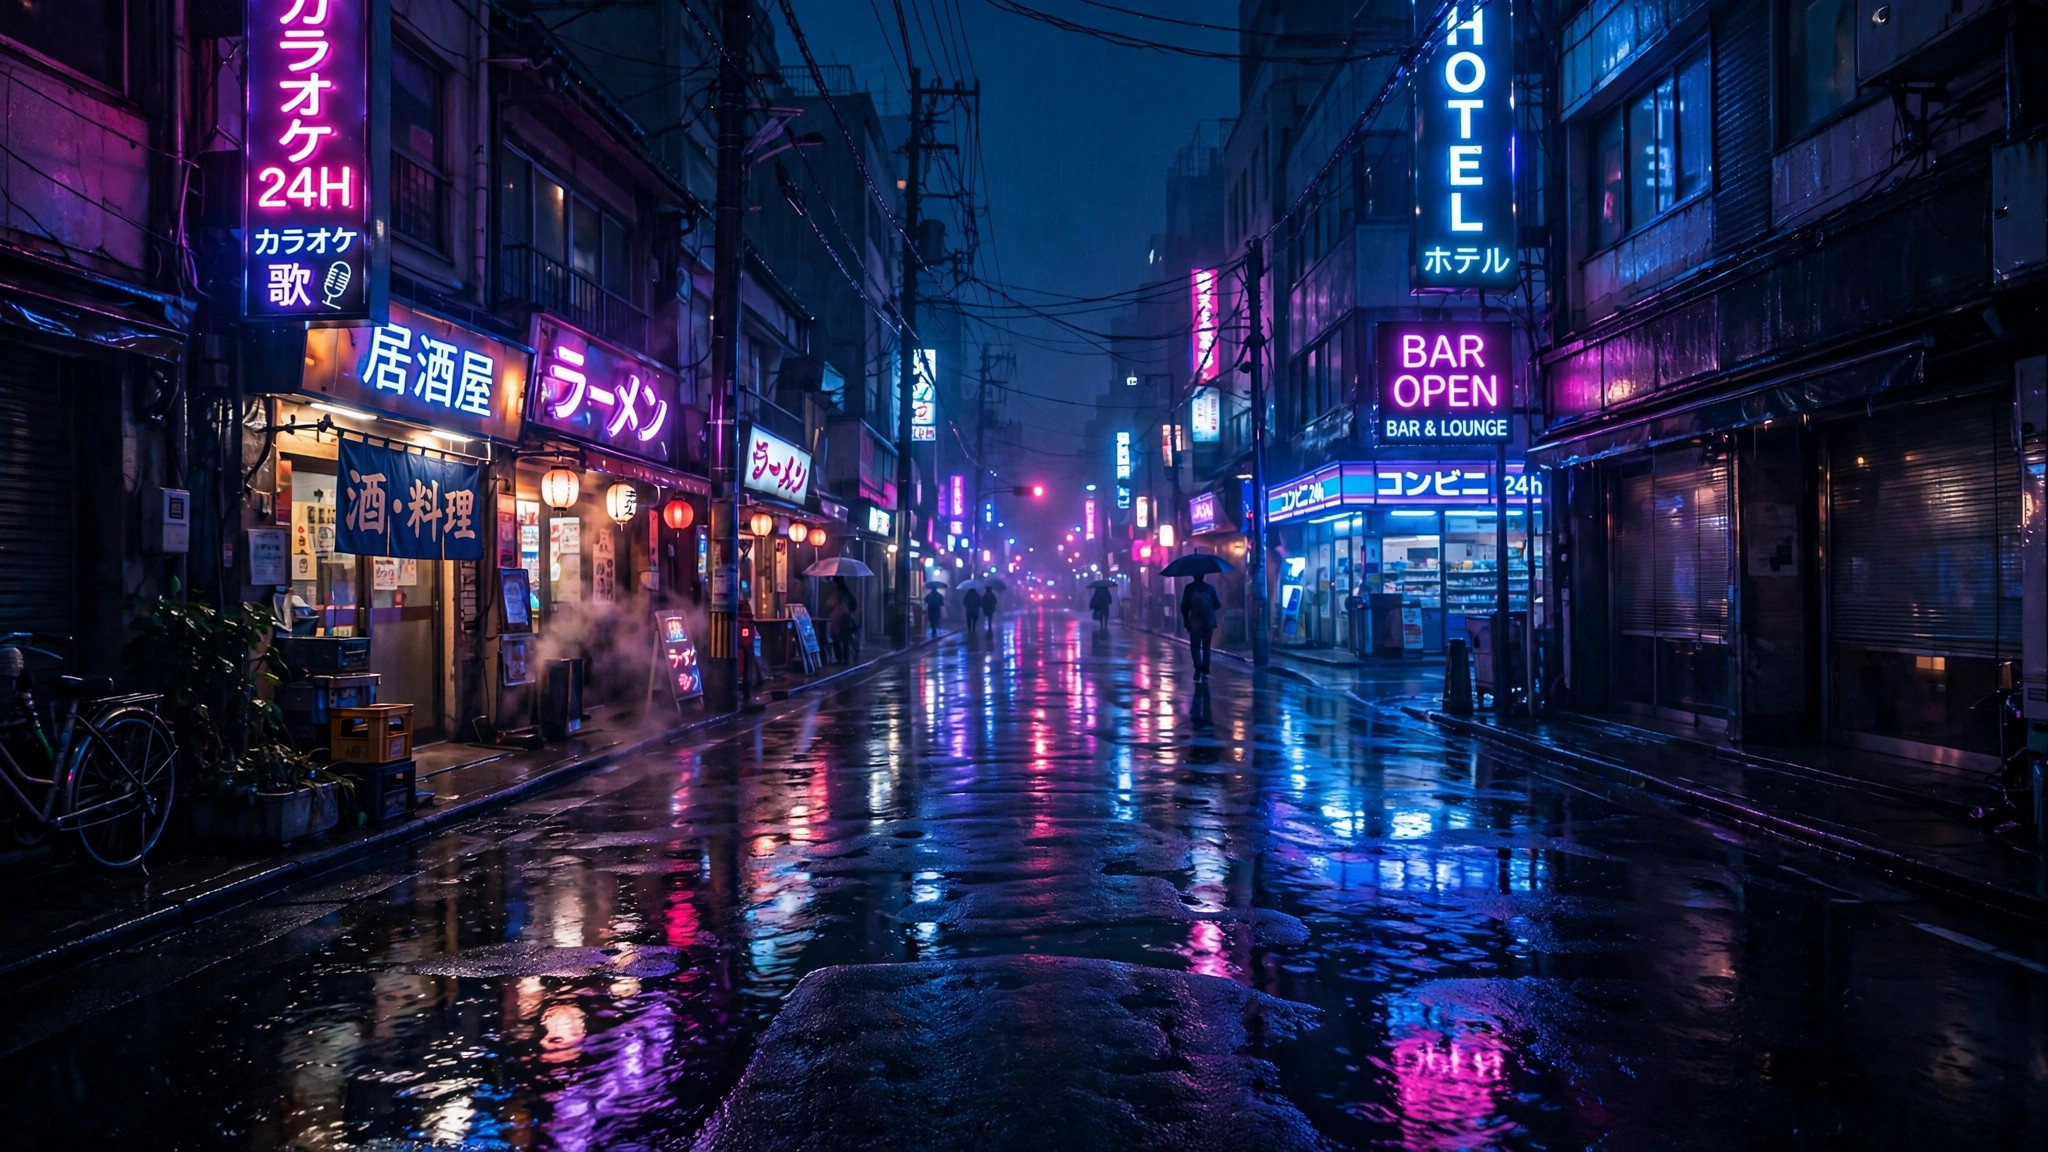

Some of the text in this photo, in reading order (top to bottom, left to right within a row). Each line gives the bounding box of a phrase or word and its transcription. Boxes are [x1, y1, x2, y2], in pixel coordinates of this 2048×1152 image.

[1445, 5, 1486, 232] HOTEL
[258, 166, 350, 208] 24H
[255, 227, 358, 255] カラオケ
[1424, 246, 1511, 275] ホテル
[267, 263, 312, 307] 歌
[1402, 335, 1485, 368] BAR
[362, 323, 494, 417] 居酒屋
[548, 346, 668, 441] ラーメン
[1393, 375, 1497, 408] OPEN
[1387, 420, 1508, 437] BAR & LOUNGE
[1377, 469, 1543, 497] コンビニ 24h
